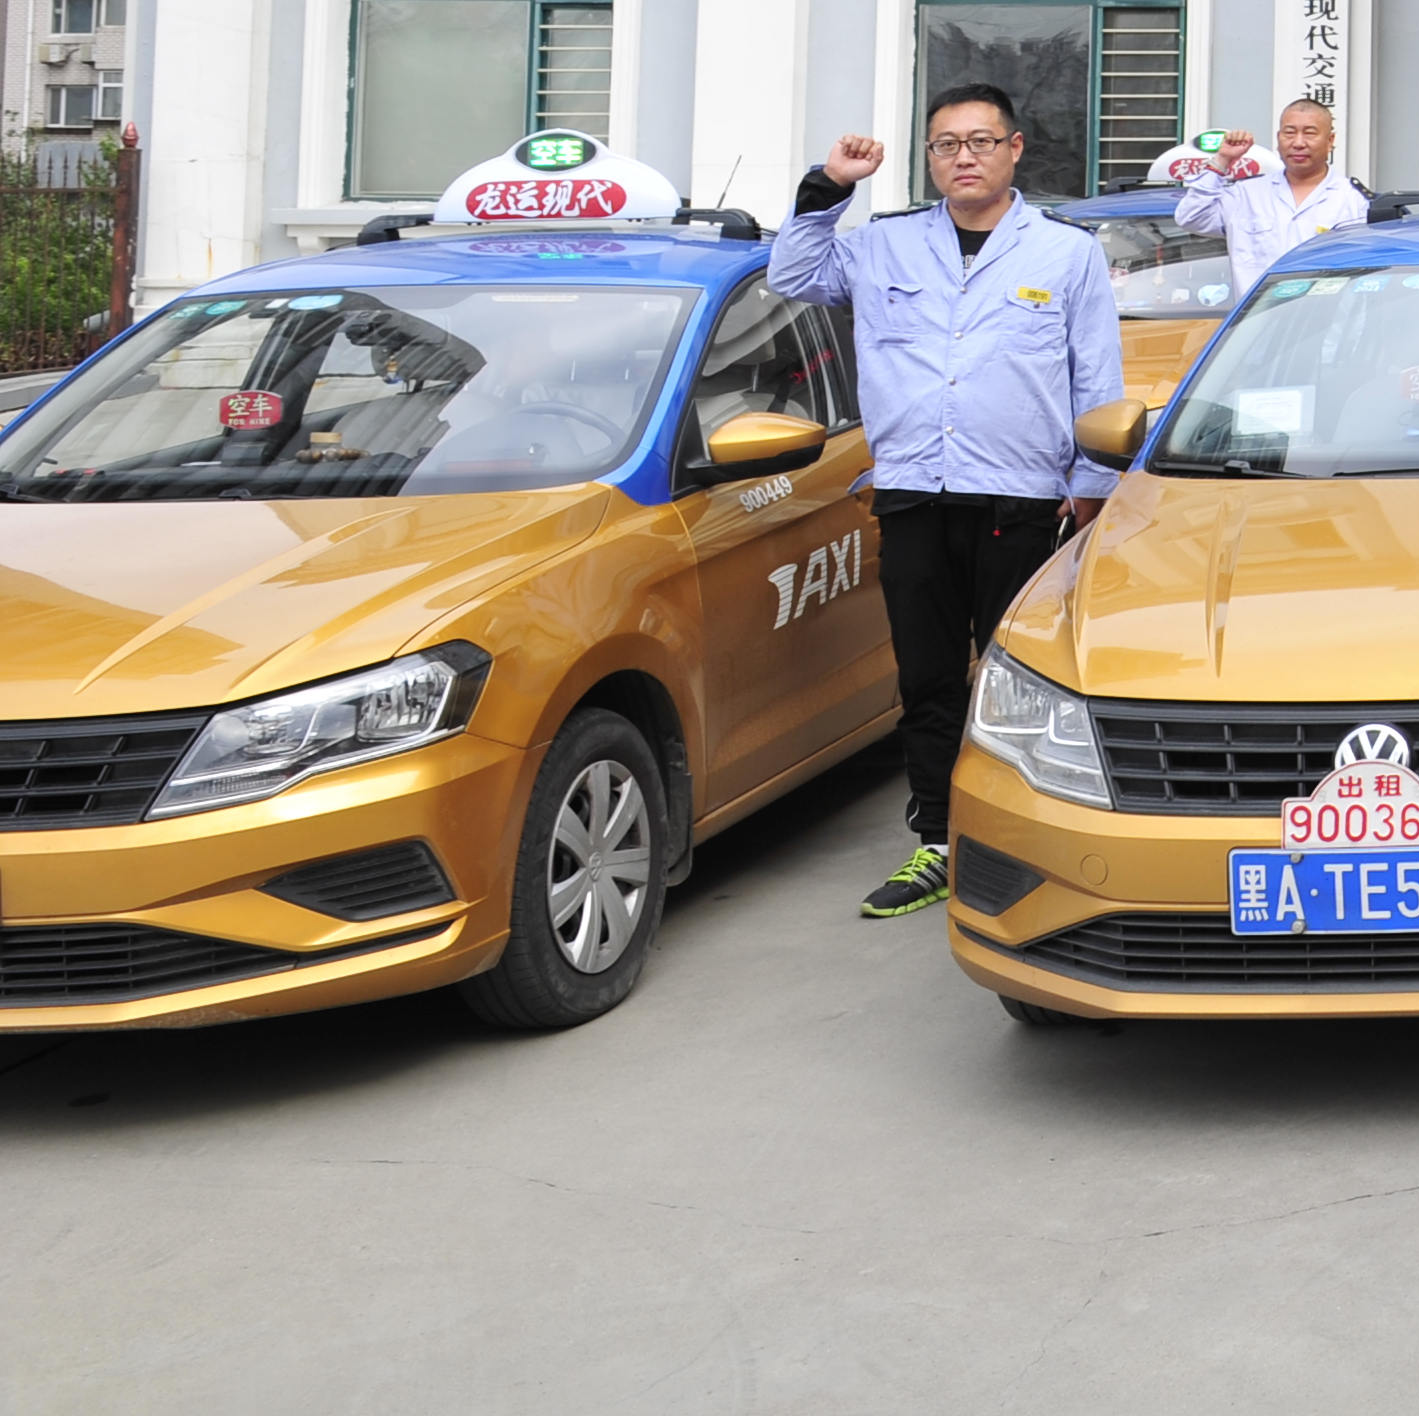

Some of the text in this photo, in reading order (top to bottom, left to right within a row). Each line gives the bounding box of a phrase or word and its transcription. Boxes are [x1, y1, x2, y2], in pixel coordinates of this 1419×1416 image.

[529, 138, 582, 166] 空车
[473, 179, 614, 218] 龙运现代
[227, 394, 274, 418] 空车
[228, 418, 271, 426] FOR HIRE
[739, 475, 793, 513] 900449
[767, 528, 861, 631] TAXI
[1338, 774, 1402, 798] 出租
